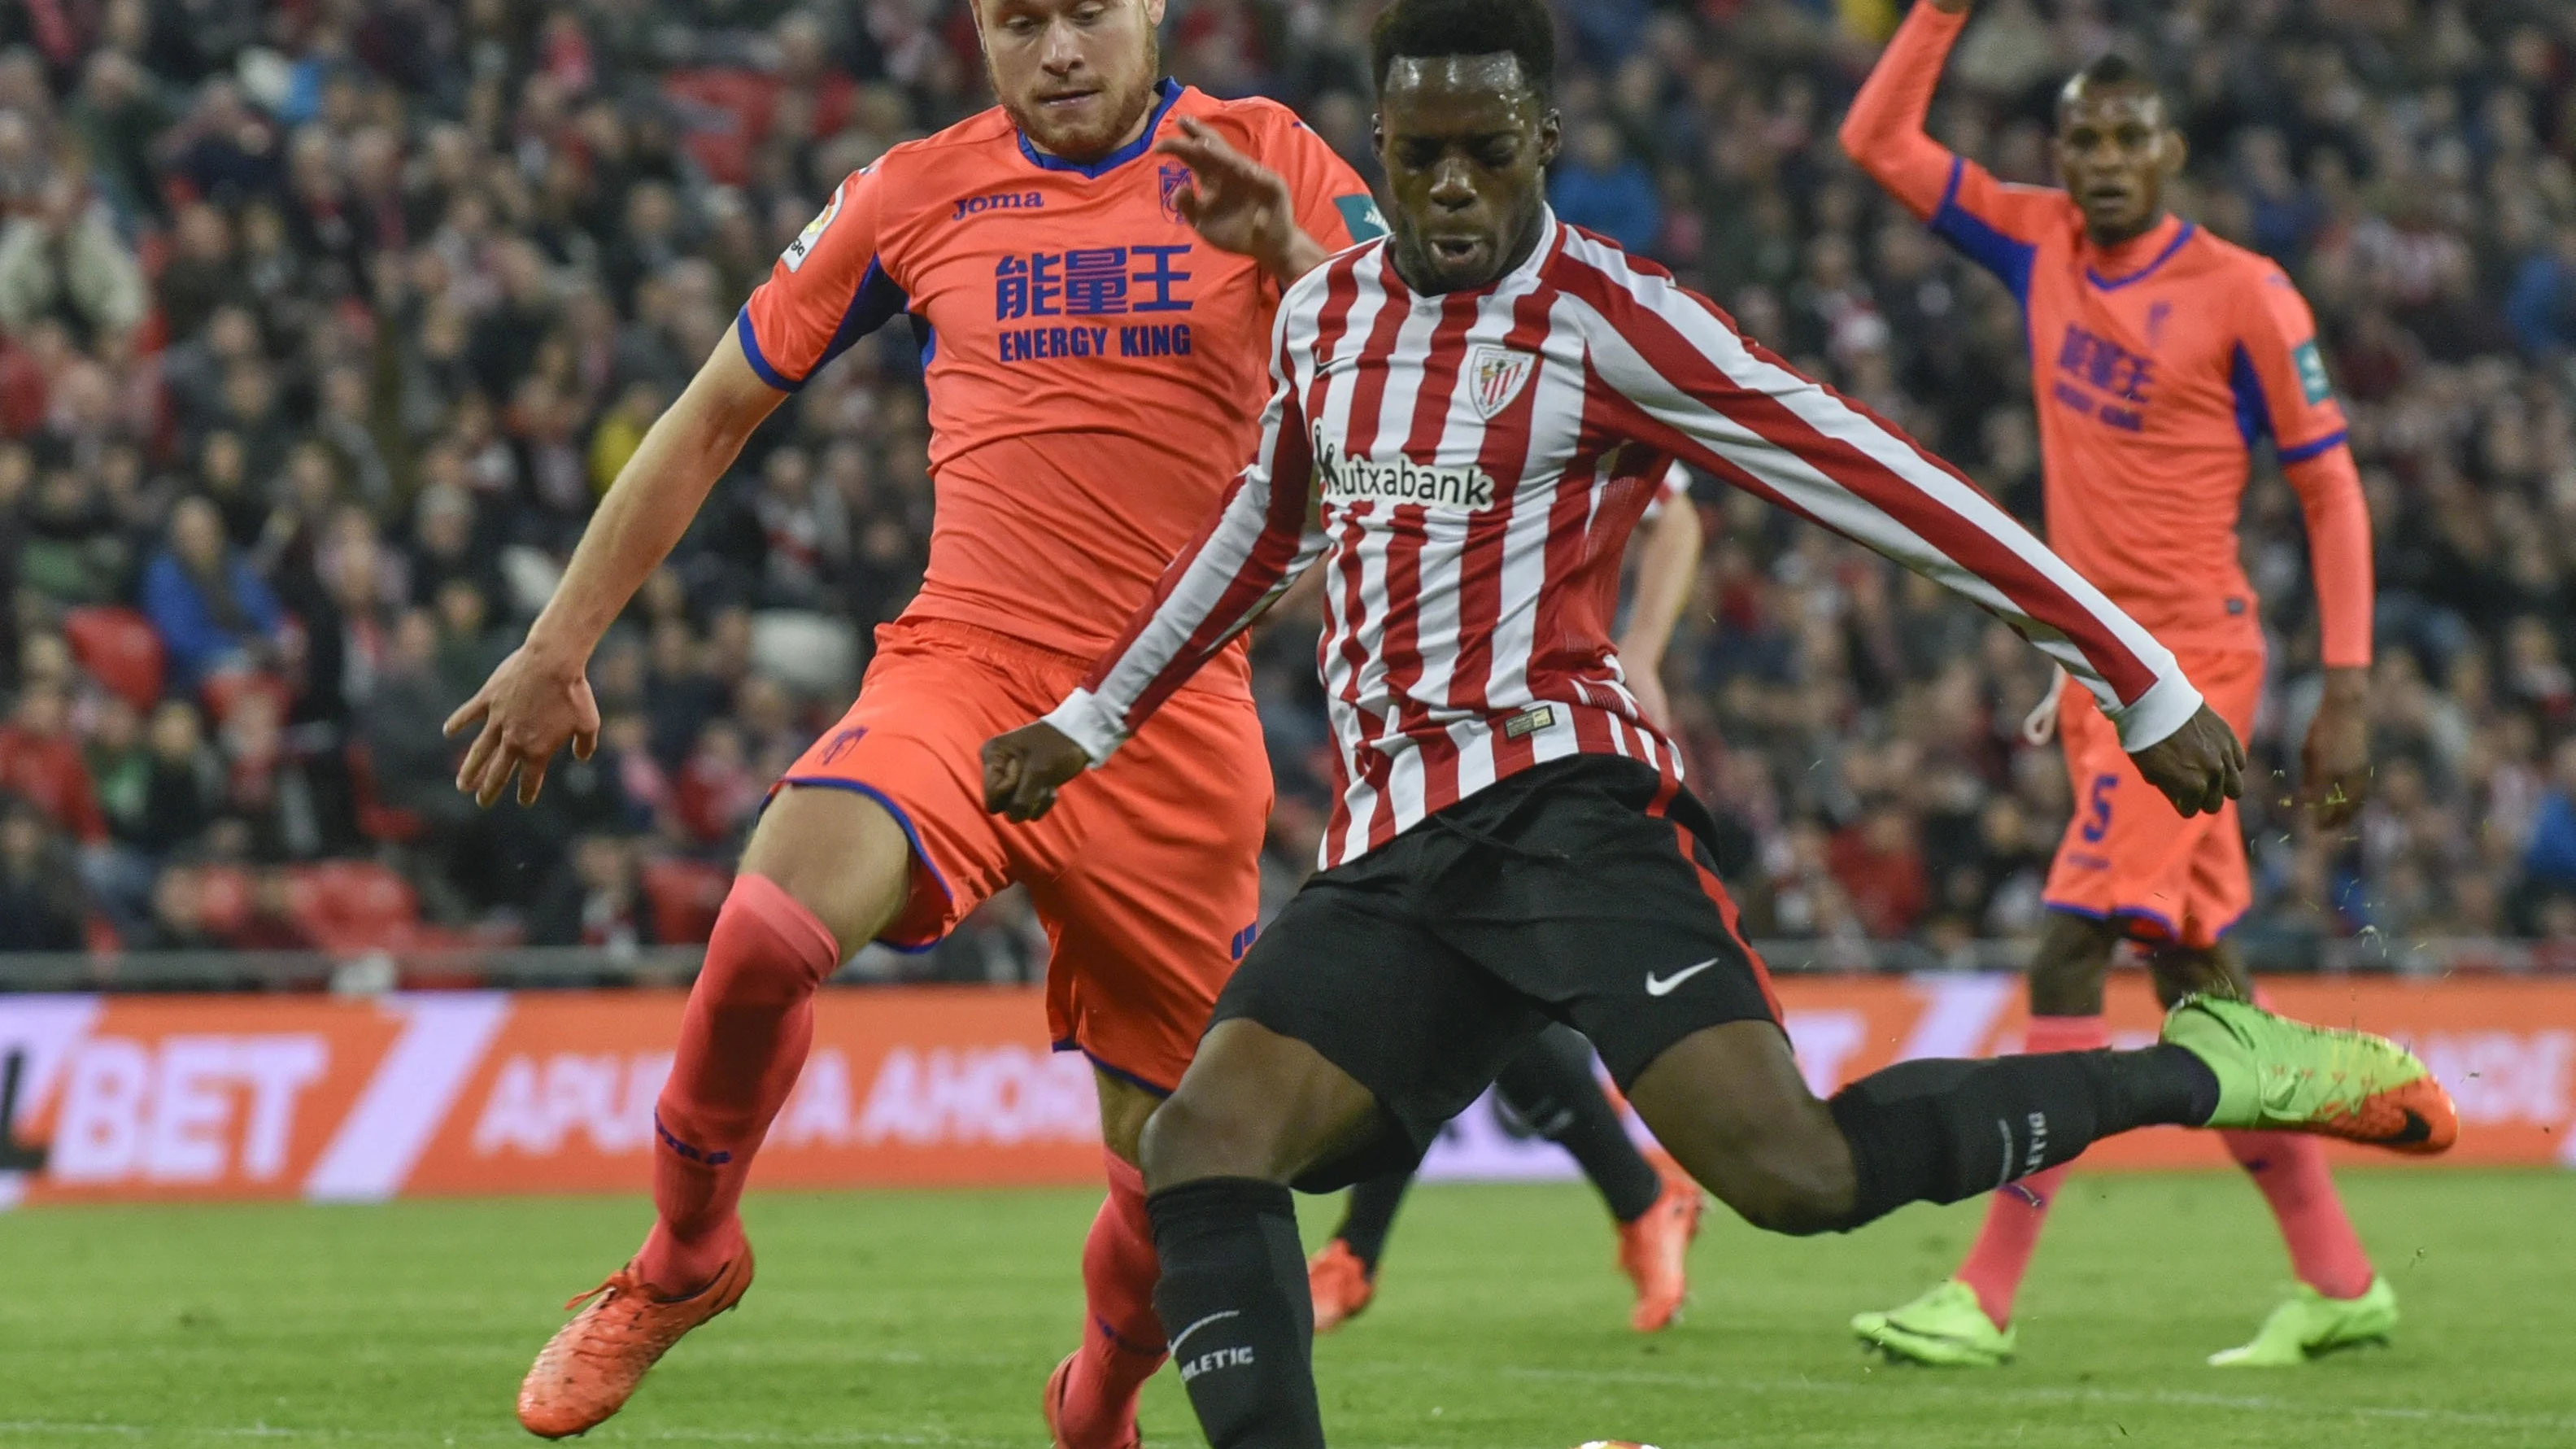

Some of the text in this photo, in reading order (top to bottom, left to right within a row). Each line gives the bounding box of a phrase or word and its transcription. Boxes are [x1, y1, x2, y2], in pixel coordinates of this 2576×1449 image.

[952, 191, 1044, 221] Joma
[996, 243, 1194, 321] 能量王
[999, 323, 1192, 362] ENERGY KING
[1314, 424, 1489, 506] Kutxabank
[2082, 774, 2119, 843] 5
